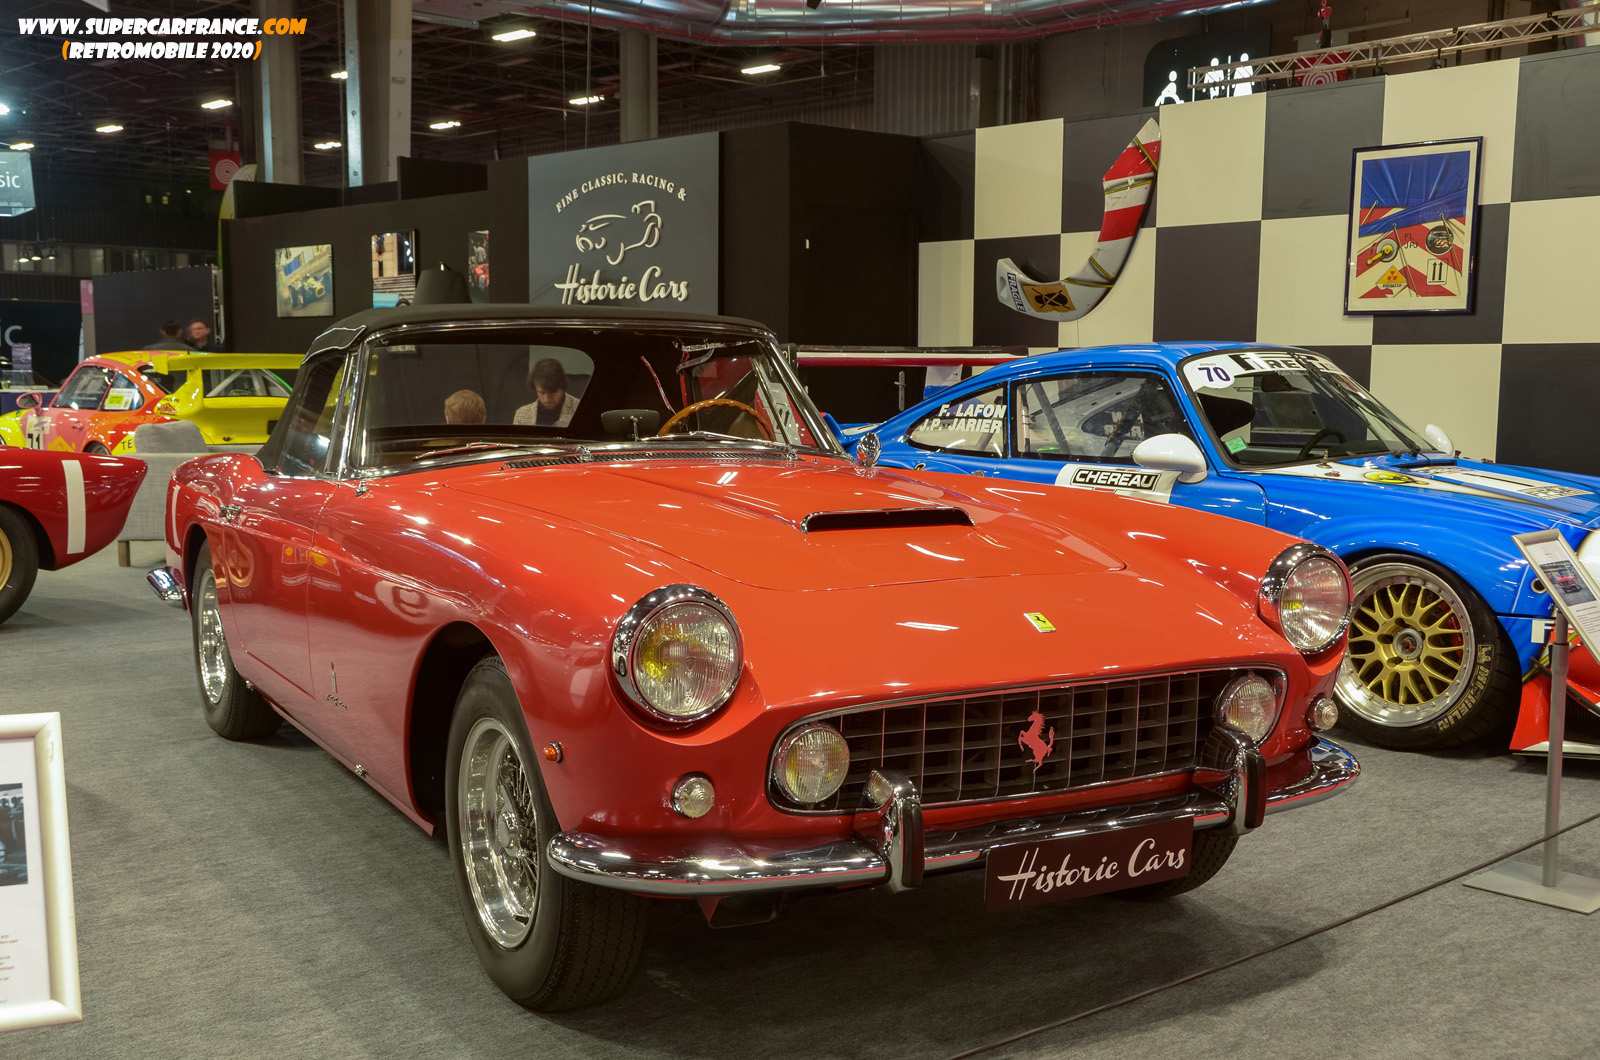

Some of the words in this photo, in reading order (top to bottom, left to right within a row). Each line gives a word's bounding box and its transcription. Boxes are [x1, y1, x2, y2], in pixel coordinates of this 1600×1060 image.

[556, 188, 579, 213] FINE
[581, 173, 628, 194] CLASSIC,
[631, 173, 674, 193] RACING
[677, 188, 687, 202] &
[1404, 241, 1418, 249] JPJ
[554, 263, 637, 305] Historic
[639, 265, 689, 302] Cars
[1007, 272, 1026, 312] FRAGILE
[1198, 366, 1231, 382] 70
[938, 404, 951, 417] F.
[955, 404, 1008, 419] LAFON
[920, 418, 943, 432] J.P.
[948, 418, 1003, 434] JARIER
[27, 433, 41, 449] 71
[1075, 470, 1155, 488] CHEREAU
[1437, 665, 1490, 731] MIHELIN
[997, 847, 1119, 900] Historic
[1128, 838, 1186, 877] Cars
